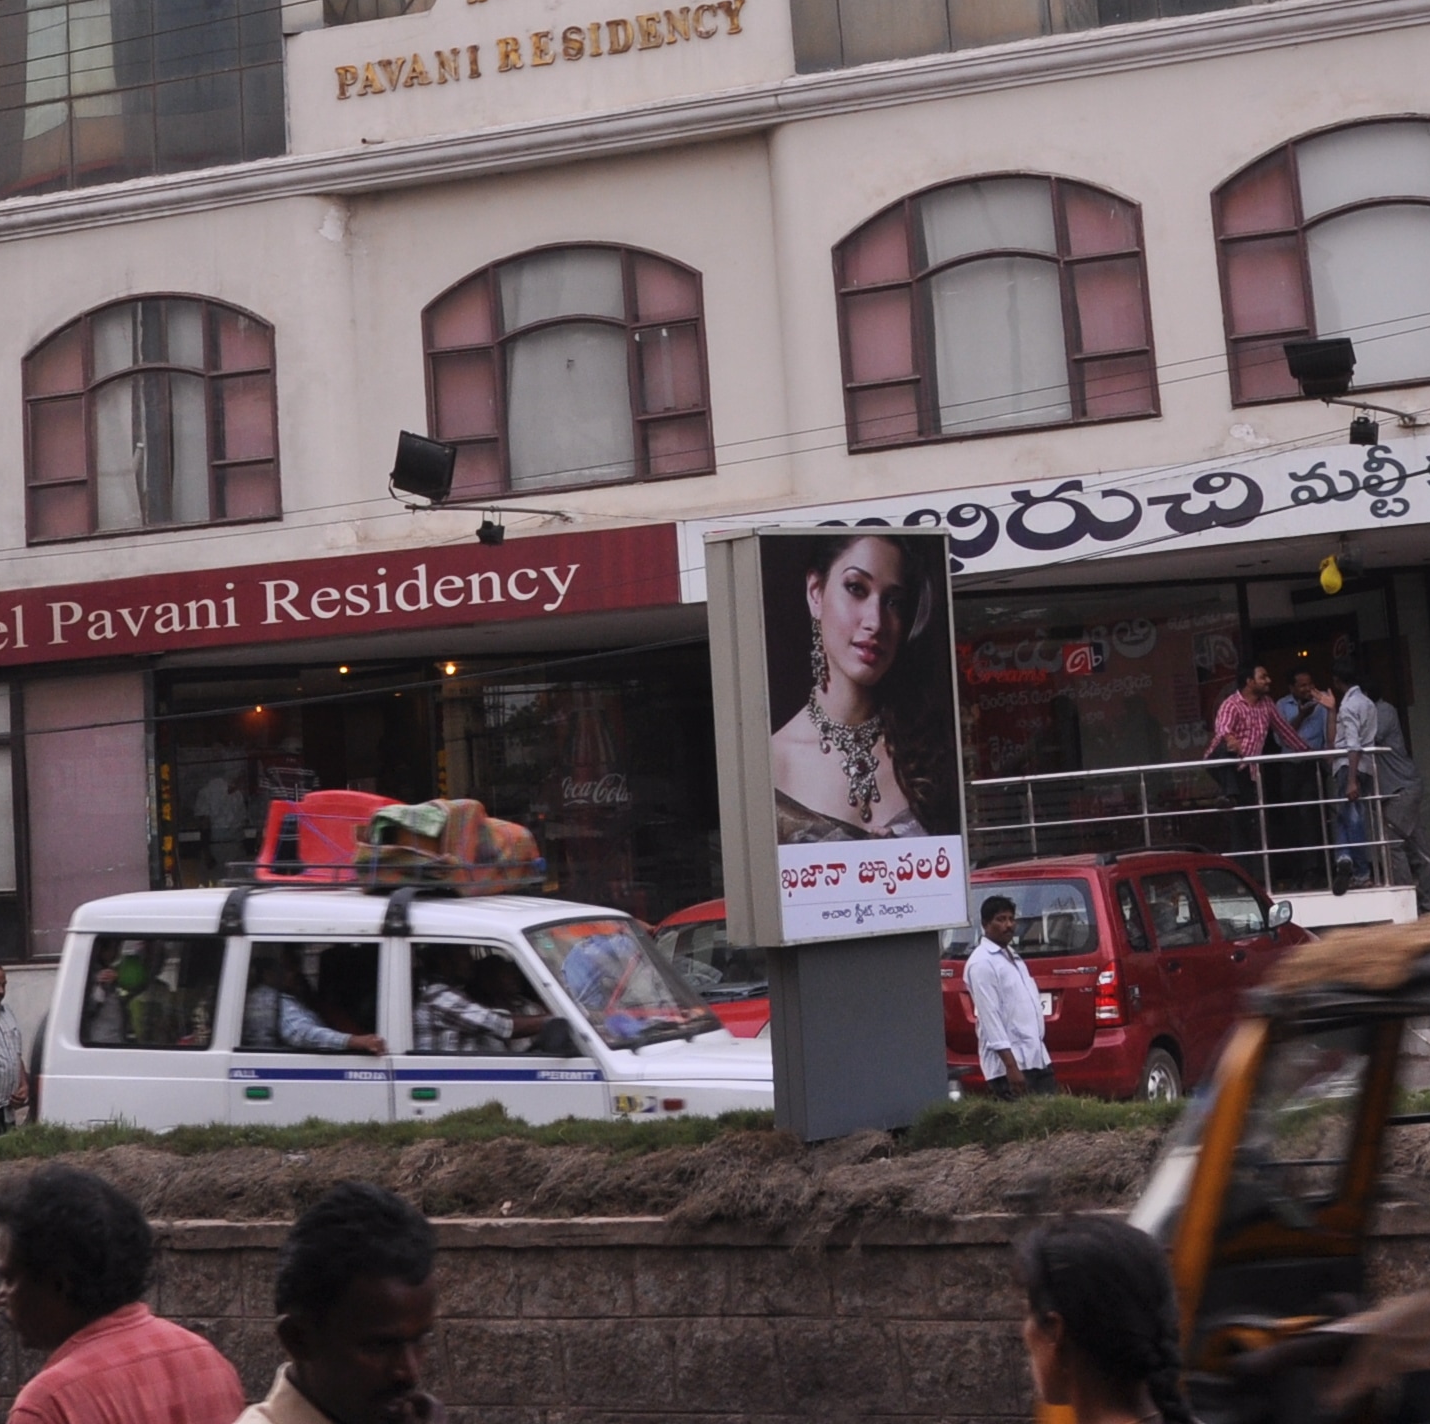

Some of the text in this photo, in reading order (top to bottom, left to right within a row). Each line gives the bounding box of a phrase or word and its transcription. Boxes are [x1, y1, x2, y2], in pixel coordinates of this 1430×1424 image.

[335, 44, 482, 100] PAVANI
[46, 582, 241, 646] Pavani
[259, 562, 580, 626] Residency
[781, 846, 951, 898] ఖజానా జ్యూవలరీ
[878, 903, 917, 919] నెల్లూరు.
[344, 1070, 389, 1081] INDIA
[536, 1070, 598, 1081] PERMIT
